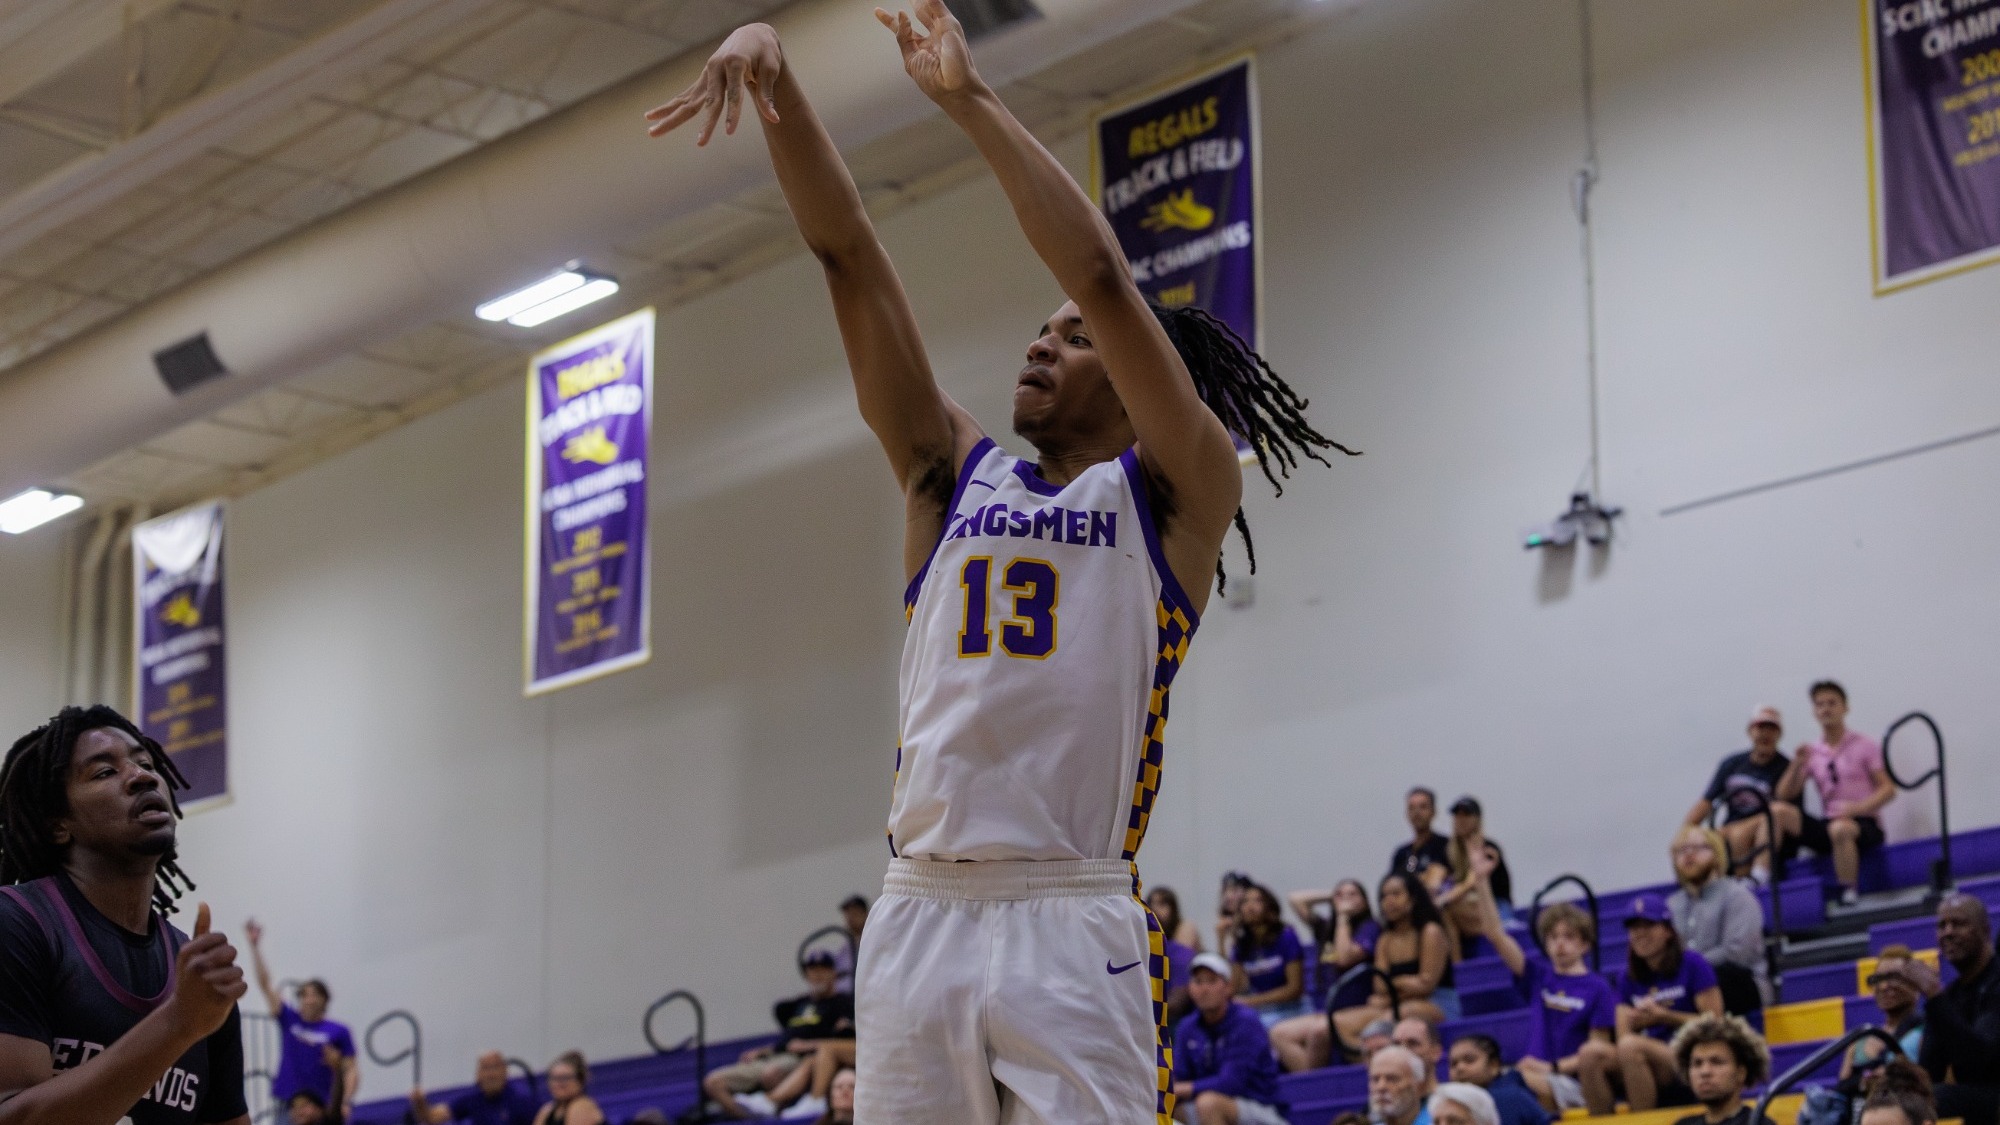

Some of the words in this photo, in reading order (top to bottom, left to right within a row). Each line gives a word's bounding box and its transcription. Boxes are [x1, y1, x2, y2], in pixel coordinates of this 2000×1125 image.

[1128, 96, 1219, 159] REGALS
[1105, 153, 1171, 214] TRACK
[1188, 138, 1245, 174] FIELD
[958, 555, 1060, 660] 13
